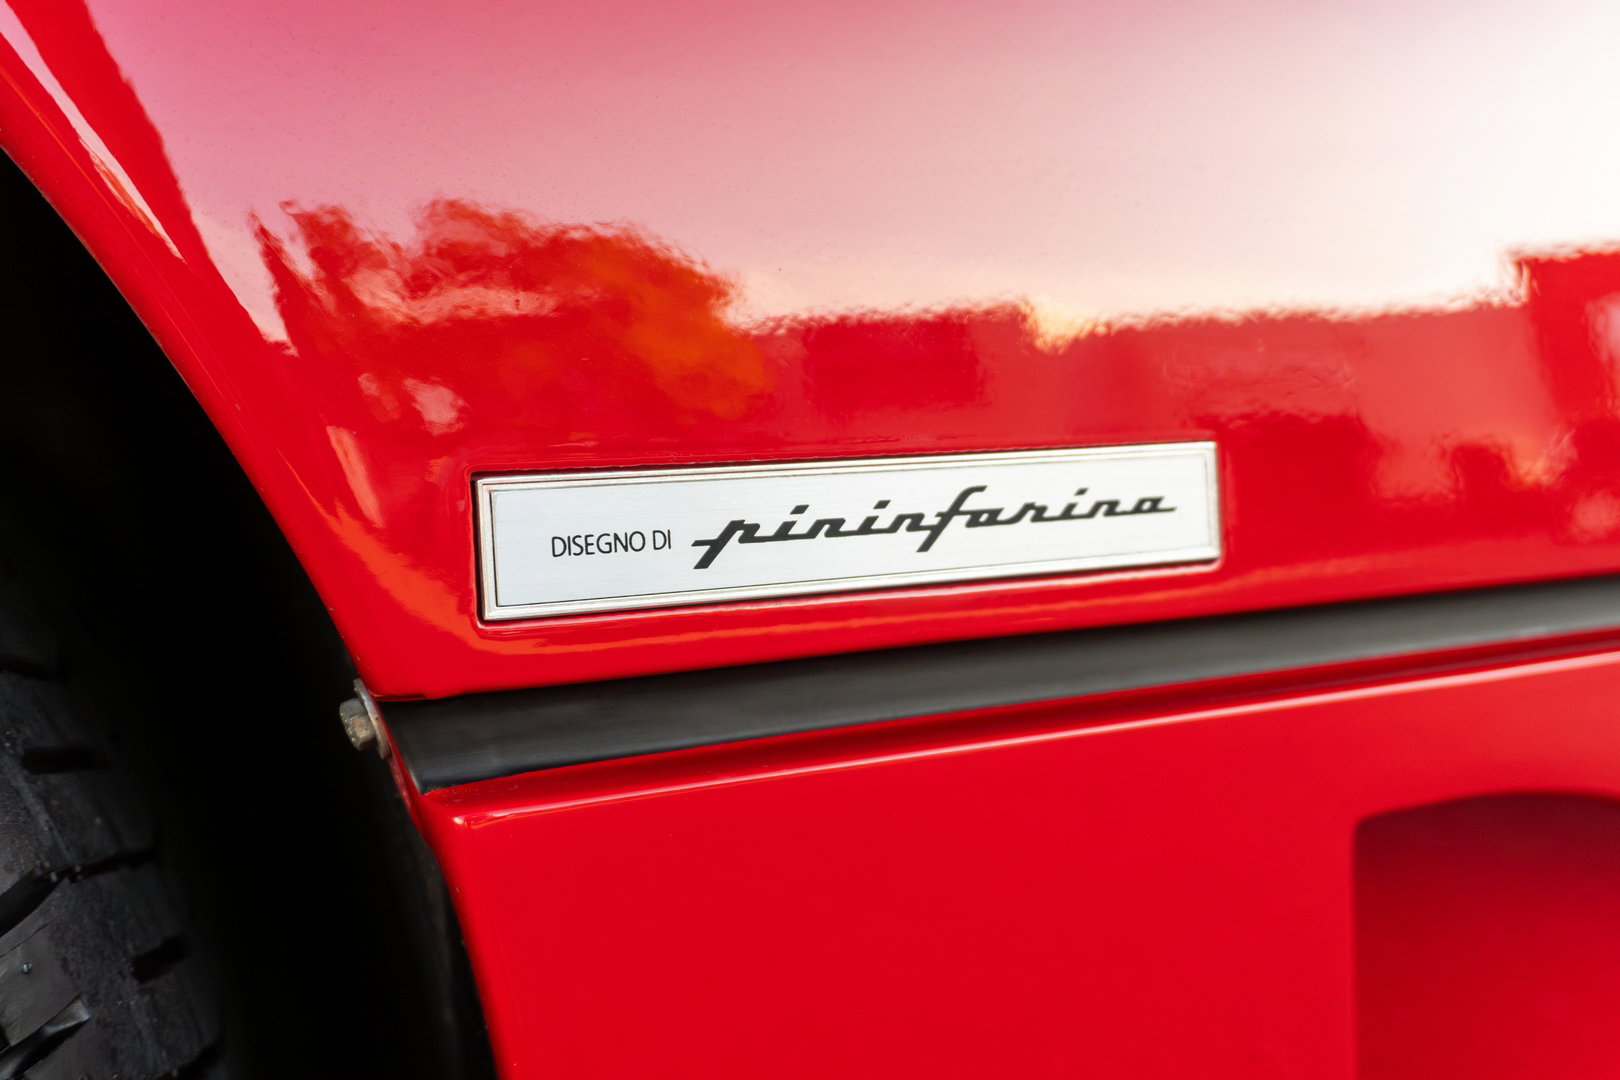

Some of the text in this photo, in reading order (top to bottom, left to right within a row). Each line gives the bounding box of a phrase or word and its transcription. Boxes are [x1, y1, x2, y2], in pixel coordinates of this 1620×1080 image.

[551, 485, 1177, 570] DISEGNO DI pininfarina
